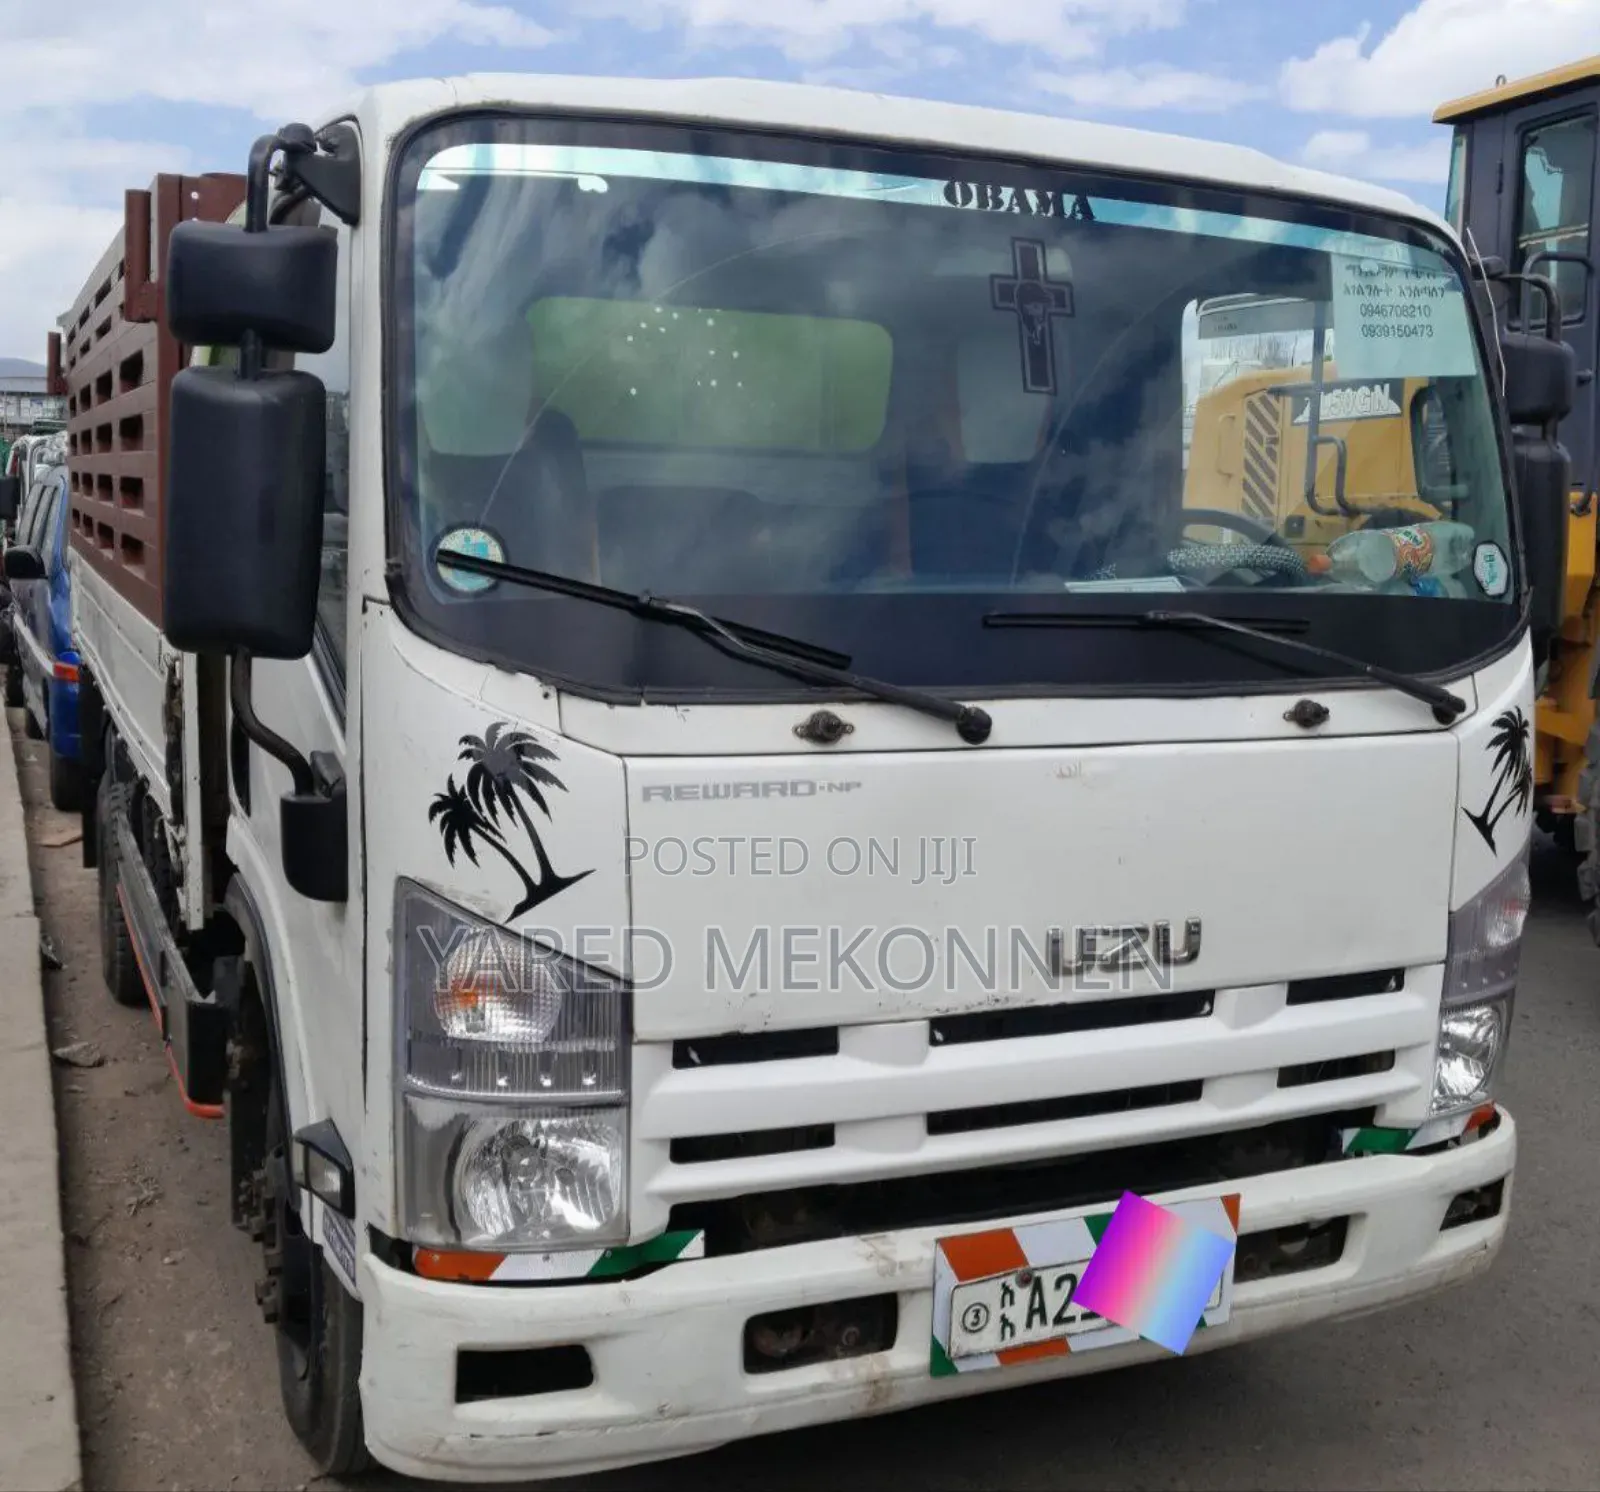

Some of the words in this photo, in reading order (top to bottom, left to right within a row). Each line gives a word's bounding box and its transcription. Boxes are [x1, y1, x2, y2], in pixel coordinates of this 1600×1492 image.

[943, 179, 1095, 221] OBAMA
[1360, 303, 1431, 318] 0946708210
[1361, 324, 1434, 338] 0939150473
